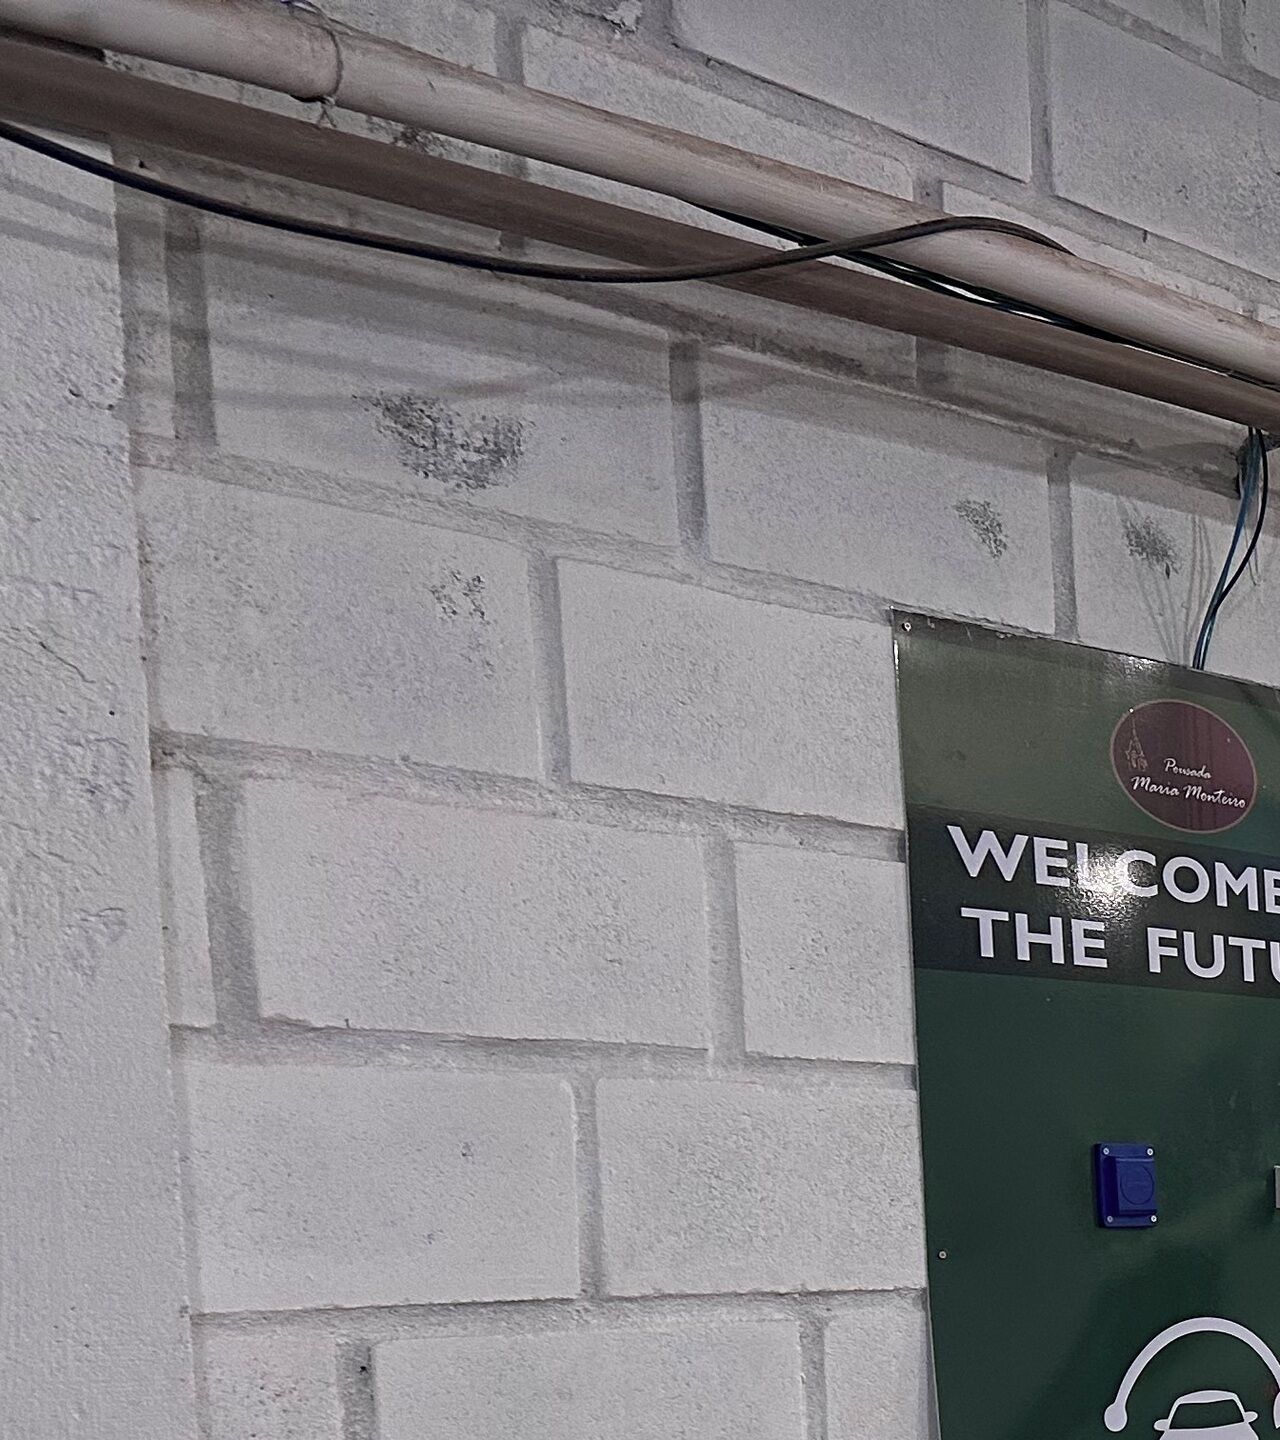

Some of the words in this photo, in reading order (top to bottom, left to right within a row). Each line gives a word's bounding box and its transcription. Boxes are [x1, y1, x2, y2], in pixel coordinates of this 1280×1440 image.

[1163, 757, 1212, 779] Pousada
[1131, 776, 1180, 796] Maria
[1183, 784, 1246, 809] Monteiro
[960, 906, 1108, 968] THE
